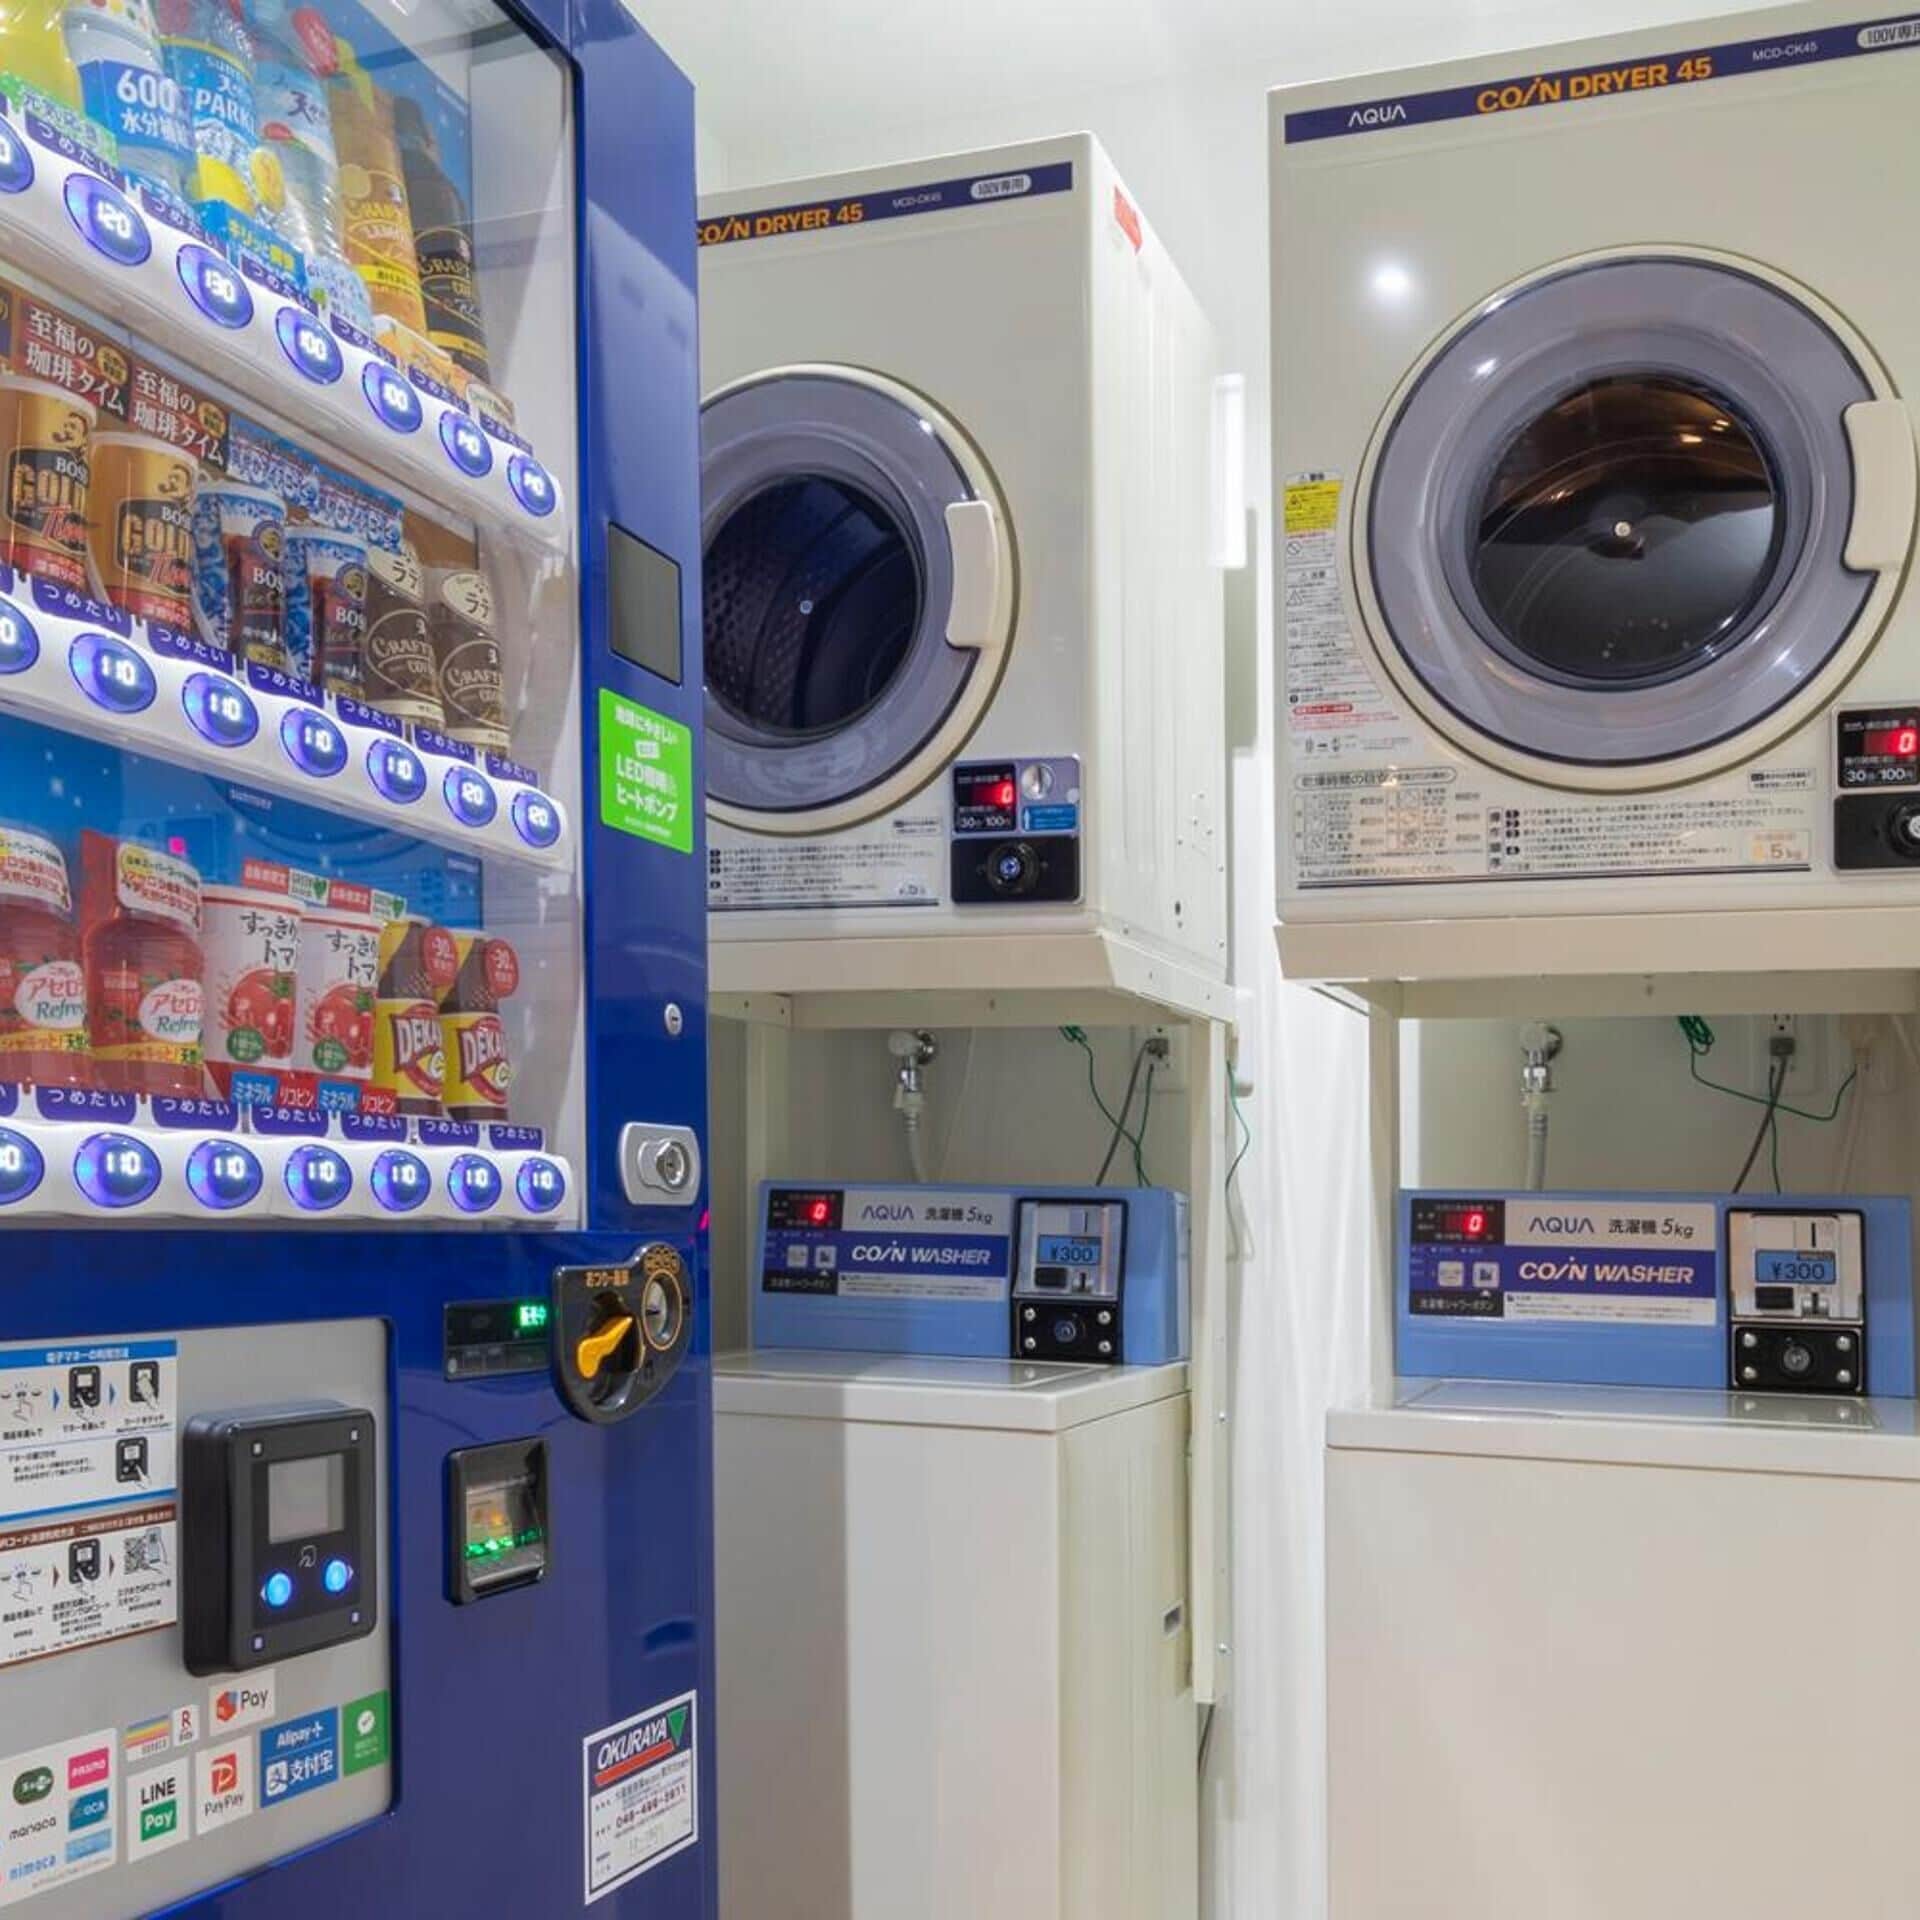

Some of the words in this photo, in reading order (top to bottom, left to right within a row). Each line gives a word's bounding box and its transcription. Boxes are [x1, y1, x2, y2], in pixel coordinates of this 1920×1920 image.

[1752, 41, 1819, 62] MCD-CK45
[1347, 104, 1406, 128] AQUA
[1569, 64, 1669, 99] DRYER
[1676, 55, 1712, 81] 45
[756, 208, 830, 236] DRYER
[837, 203, 864, 223] 45
[29, 306, 95, 360] 至福の
[27, 341, 124, 416] 珈琲タイム
[136, 366, 197, 416] 至福の
[133, 400, 225, 467] 珈琲タイム
[43, 582, 122, 625] つめたい
[156, 627, 226, 663] つめたい
[256, 666, 318, 699] つめたい
[344, 701, 397, 729] つめたい
[421, 730, 471, 758] つめたい
[1899, 731, 1916, 754] 0
[47, 1087, 127, 1109] つめたい
[161, 1098, 230, 1117] つめたい
[259, 1106, 322, 1124] つめたい
[349, 1114, 402, 1130] つめたい
[425, 1121, 474, 1137] つめたい
[494, 1126, 540, 1143] つめたい
[105, 1152, 142, 1178] 110
[214, 1154, 246, 1180] 110
[307, 1160, 336, 1183] 110
[391, 1163, 418, 1186] 110
[861, 1205, 915, 1222] AQUA
[1468, 1214, 1484, 1232] 0
[1529, 1216, 1594, 1234] AQUA
[1608, 1217, 1658, 1235] 洗濯機
[1661, 1217, 1694, 1239] 5kg
[911, 1246, 991, 1266] WASHER
[1593, 1263, 1694, 1285] WASHER
[1769, 1261, 1826, 1281] ¥300
[241, 1689, 269, 1711] Pay
[598, 1716, 668, 1770] OKURAYA
[289, 1749, 333, 1783] 支付宝
[141, 1776, 176, 1804] LINE
[204, 1793, 245, 1818] PayPay
[145, 1808, 175, 1832] Pay
